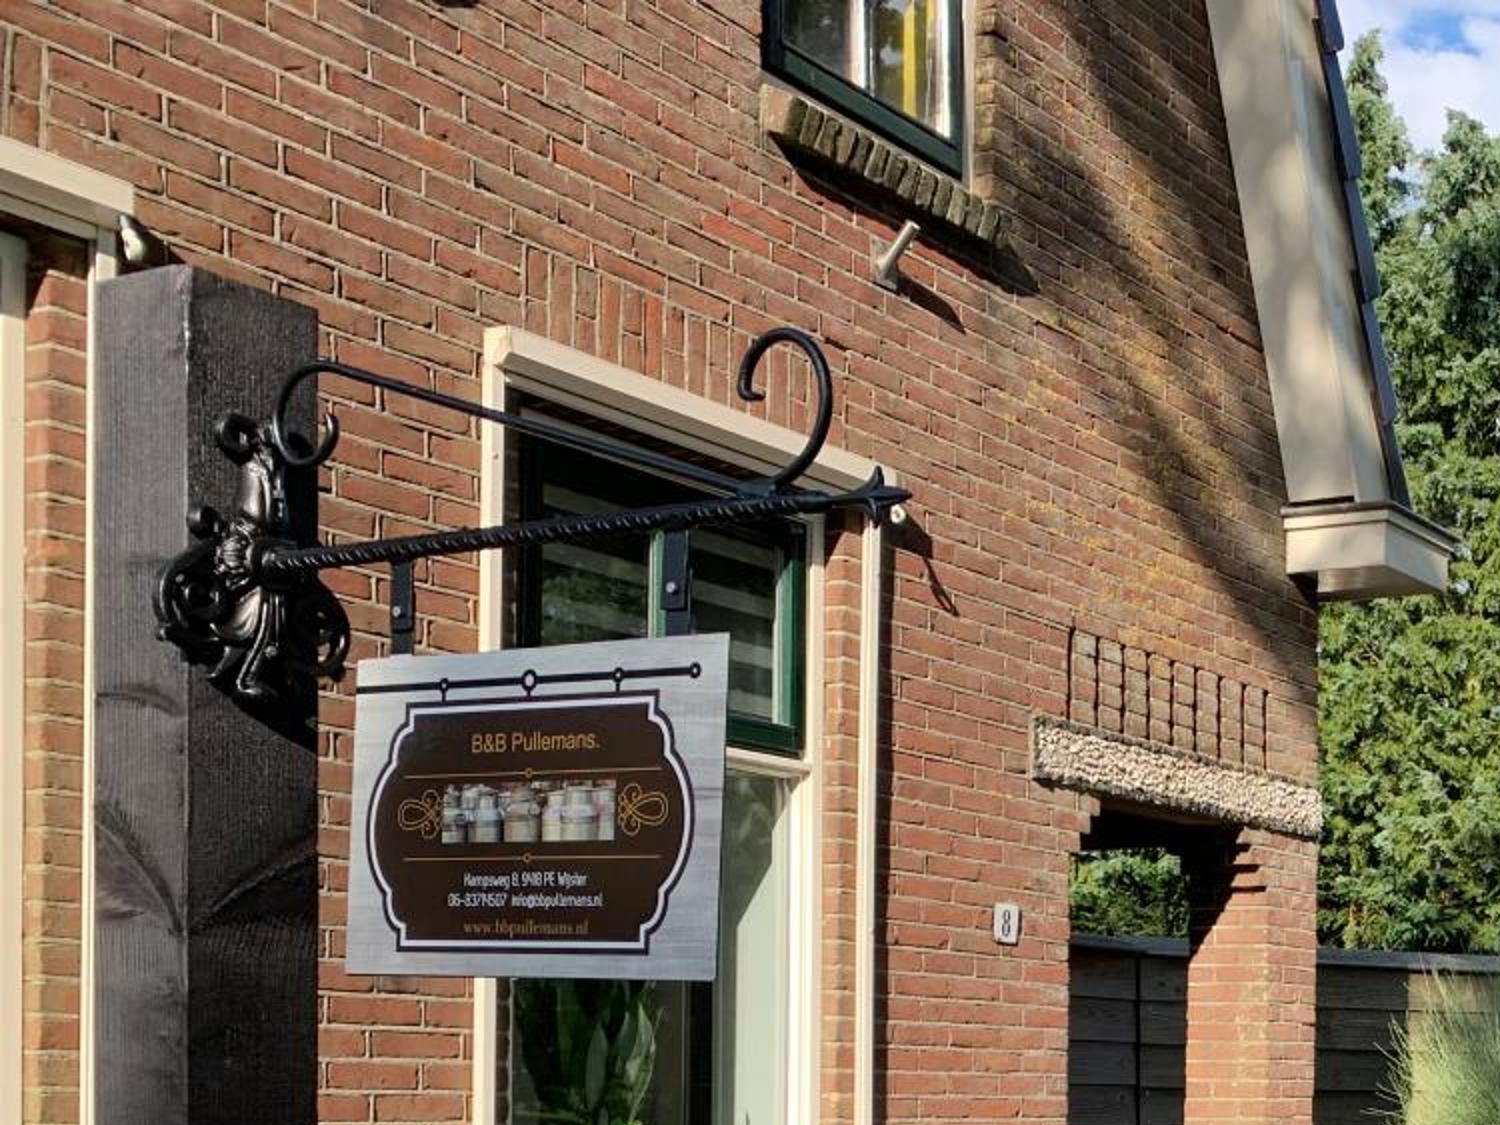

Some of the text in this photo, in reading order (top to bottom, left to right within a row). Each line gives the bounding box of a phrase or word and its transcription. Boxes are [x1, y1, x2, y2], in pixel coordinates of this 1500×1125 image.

[471, 731, 600, 753] B&B Pullemans.
[543, 871, 556, 886] PE
[1001, 909, 1011, 938] 8
